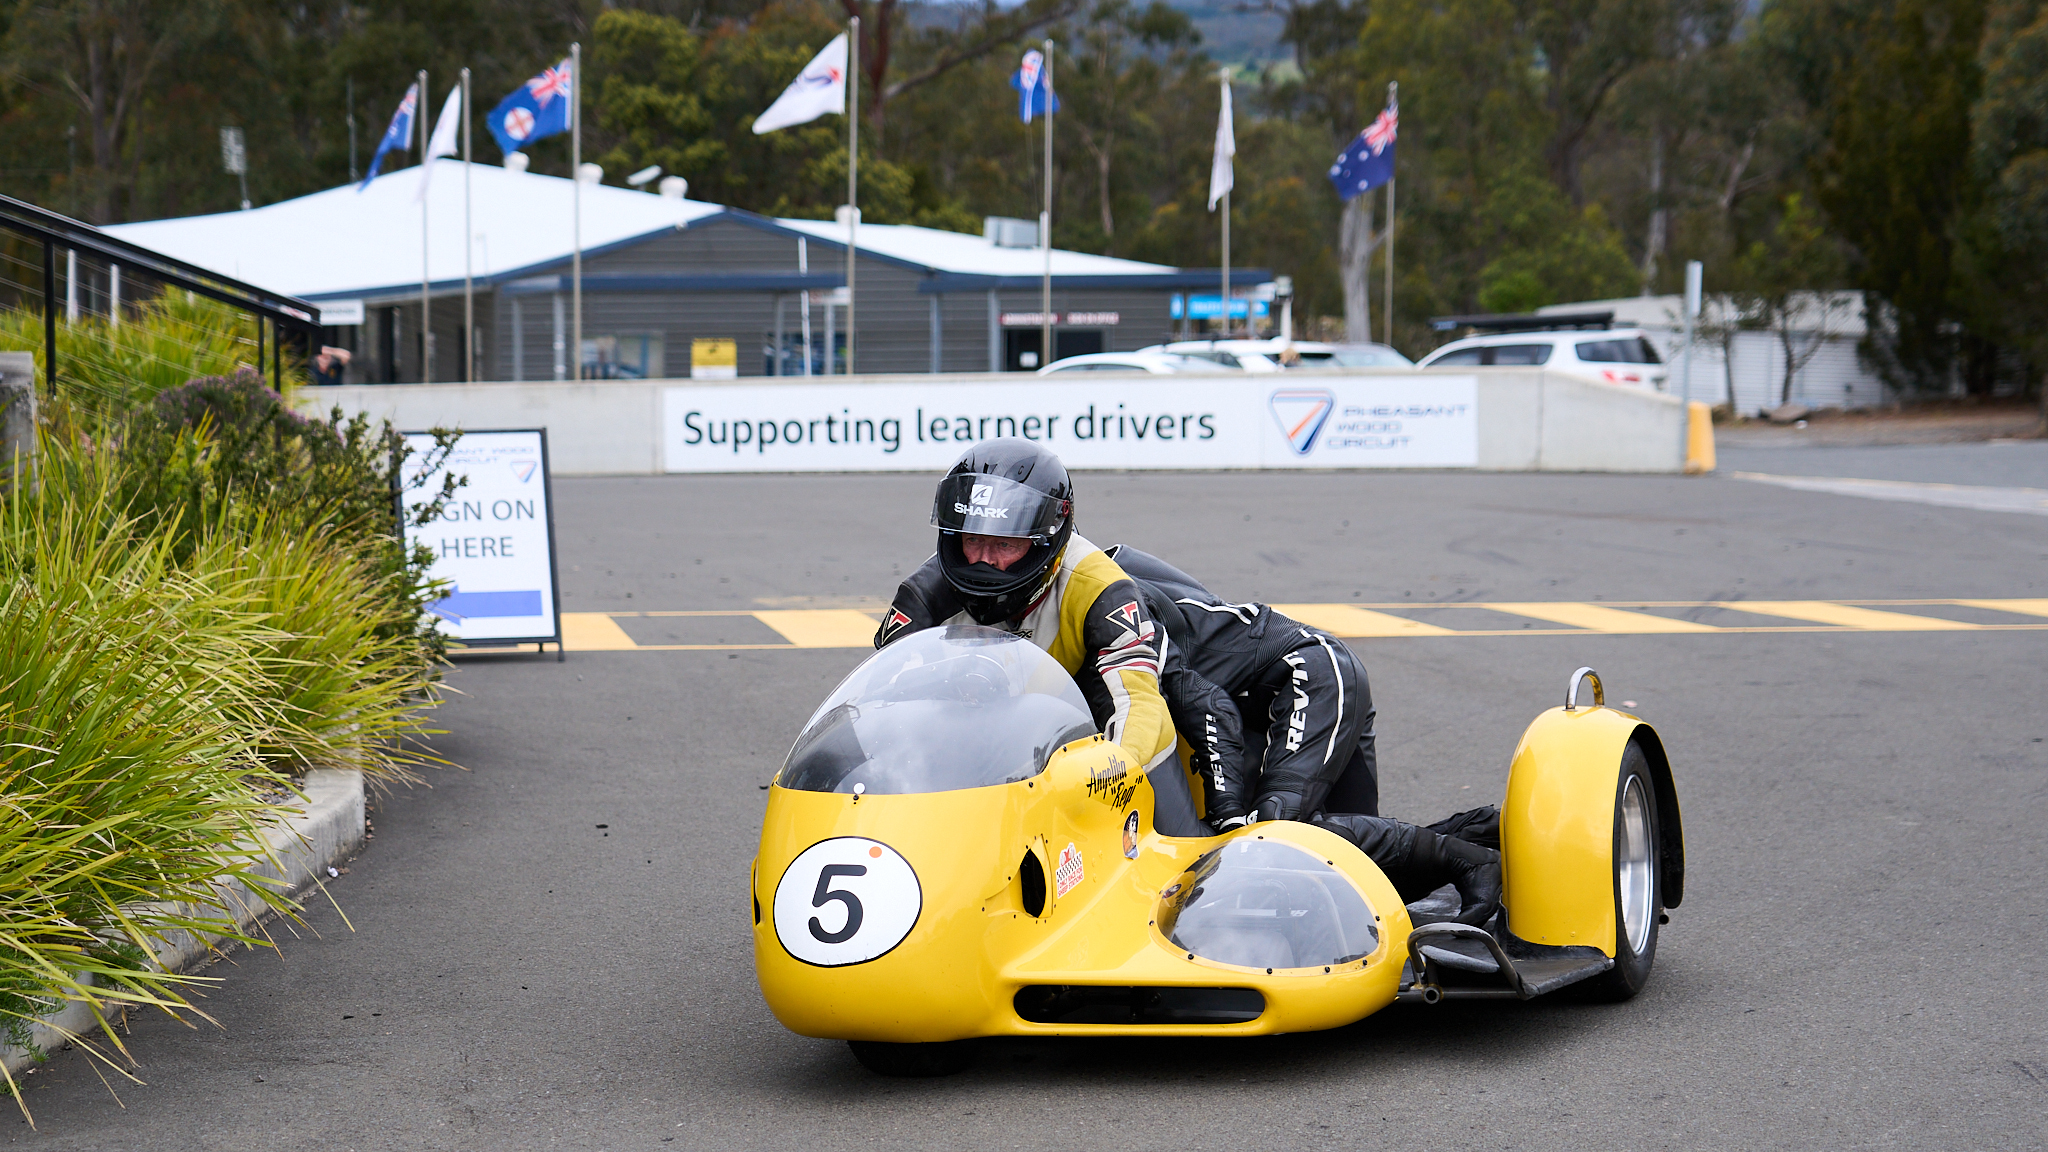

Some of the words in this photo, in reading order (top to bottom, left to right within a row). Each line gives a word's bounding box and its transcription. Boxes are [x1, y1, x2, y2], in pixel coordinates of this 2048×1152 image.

[1343, 404, 1469, 417] PHEASANT
[684, 406, 900, 453] Supporting
[916, 407, 1061, 443] learner
[1074, 403, 1216, 440] drivers
[1337, 421, 1401, 433] WOOD
[1327, 436, 1410, 448] CIRCUIT
[434, 500, 482, 522] GN
[492, 500, 535, 520] ON
[954, 502, 1009, 519] SHARK
[441, 536, 515, 559] HERE
[808, 864, 868, 944] 5
